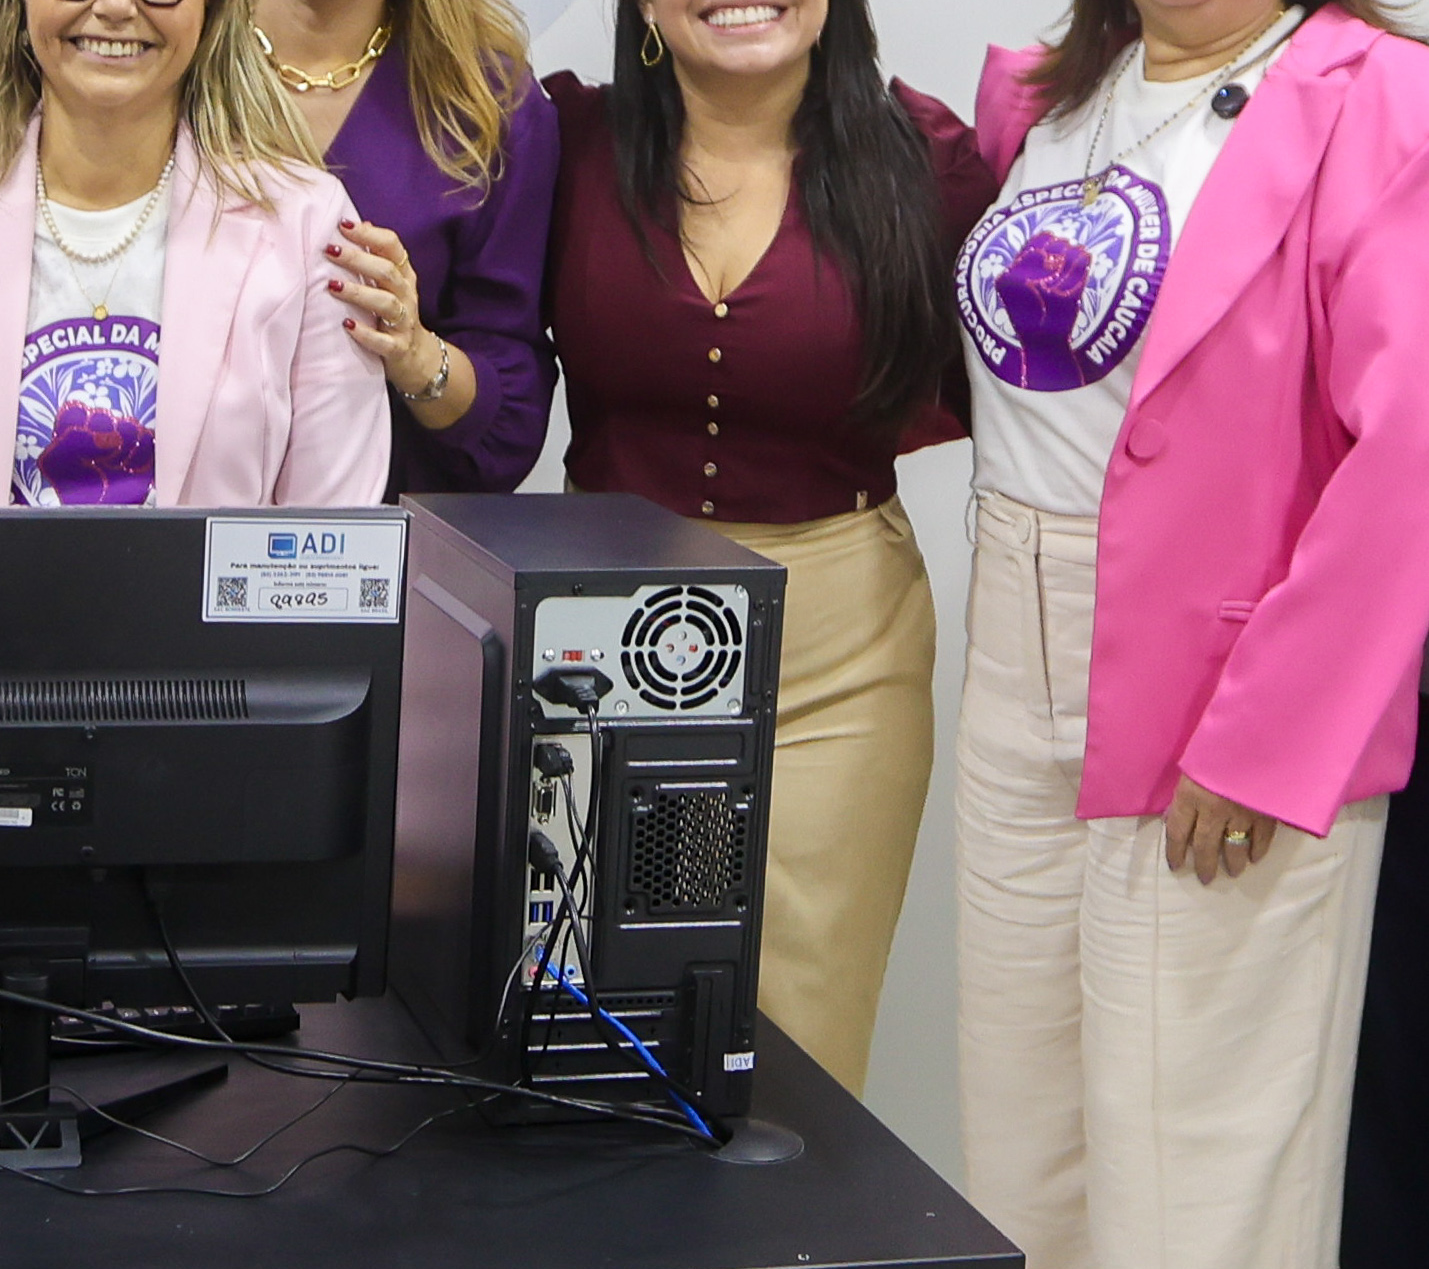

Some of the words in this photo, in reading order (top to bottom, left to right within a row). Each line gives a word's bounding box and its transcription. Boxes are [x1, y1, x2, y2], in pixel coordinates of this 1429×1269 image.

[1132, 243, 1160, 274] DE
[955, 212, 1007, 365] PROCURADORIA
[1085, 276, 1150, 365] CAUCAIA
[22, 324, 106, 369] PECIAL
[110, 322, 141, 347] DA
[301, 532, 346, 554] ADI
